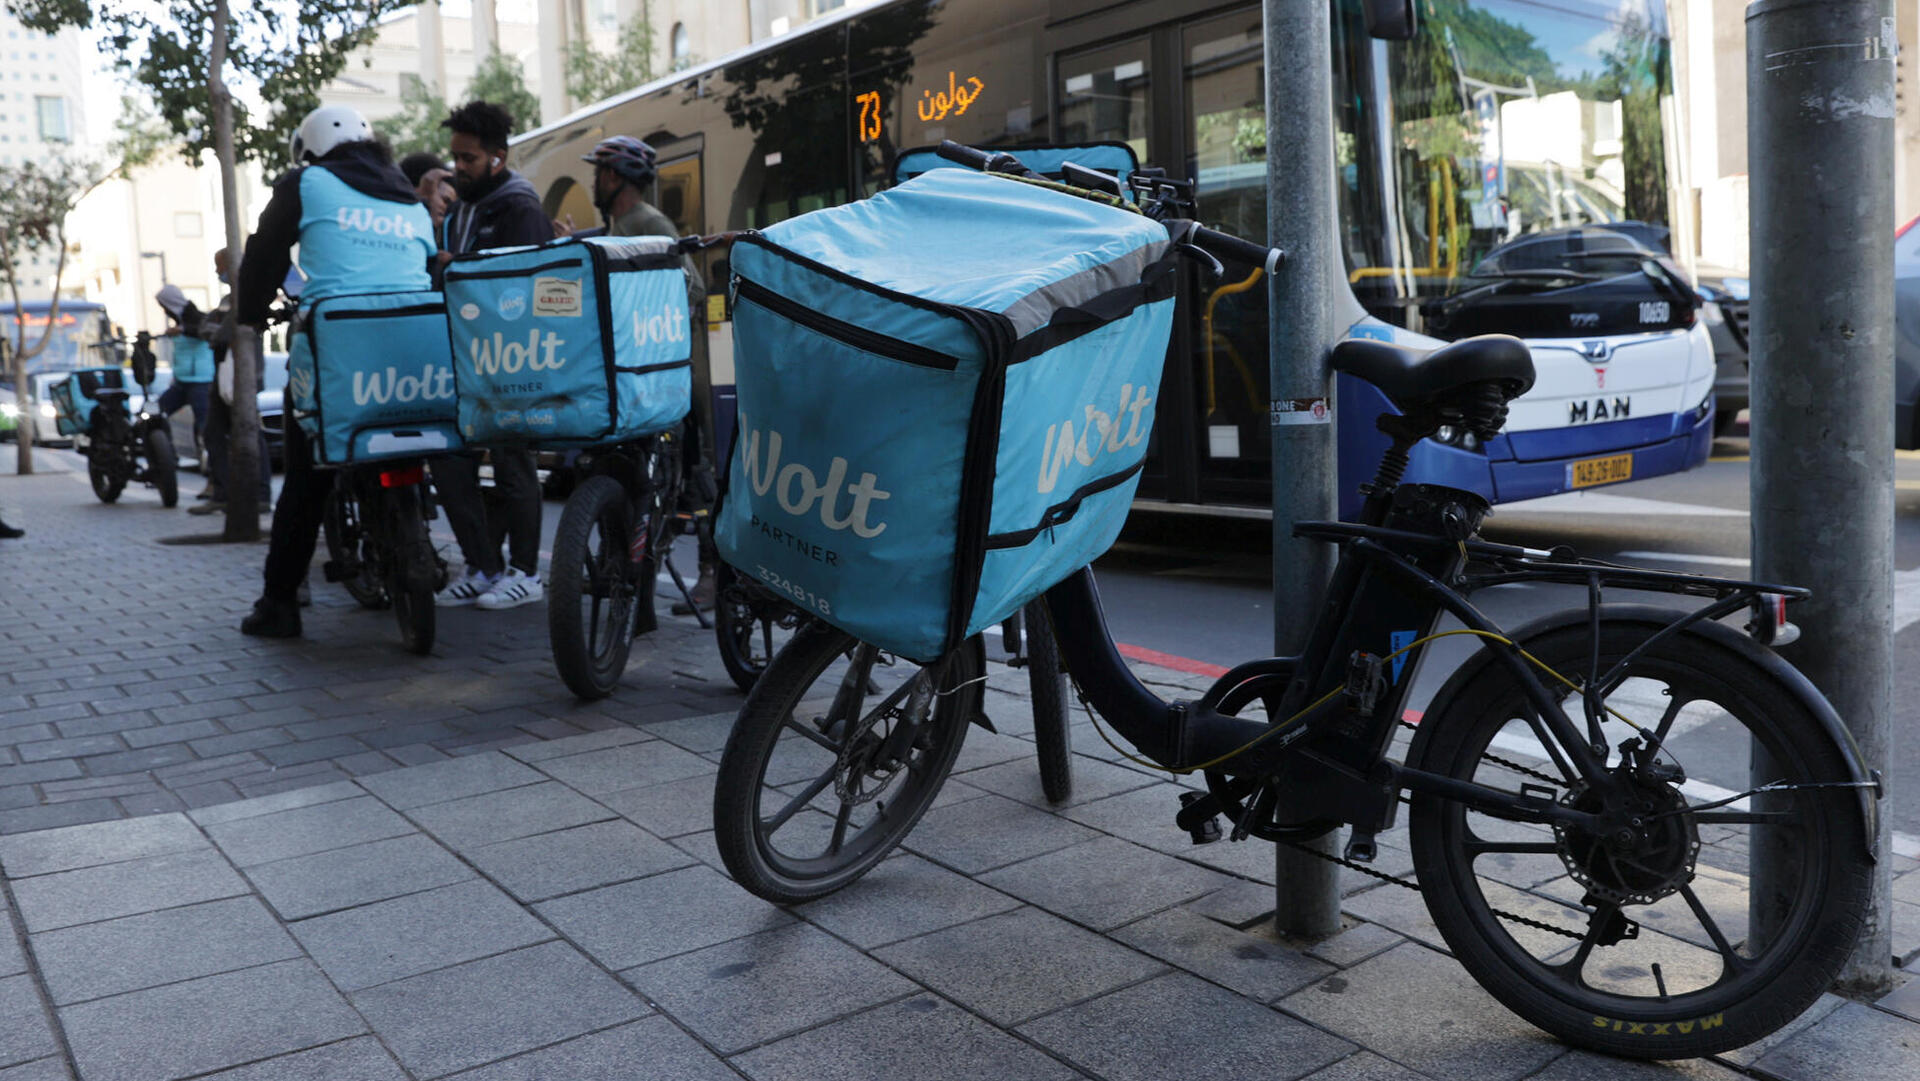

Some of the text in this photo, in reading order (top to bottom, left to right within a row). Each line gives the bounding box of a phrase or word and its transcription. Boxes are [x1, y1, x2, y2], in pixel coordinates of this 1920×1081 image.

[856, 90, 882, 142] 73
[918, 71, 985, 122] حولون
[337, 207, 415, 240] Wolt
[633, 303, 685, 348] Wolt
[470, 328, 567, 376] Wolt
[353, 363, 455, 406] Wolt
[1569, 396, 1631, 424] MAN
[1037, 383, 1152, 494] Wolt
[741, 411, 892, 539] Wolt
[751, 514, 840, 567] PARTNER
[756, 564, 832, 617] 324818
[1591, 1012, 1725, 1037] MAXXIS
